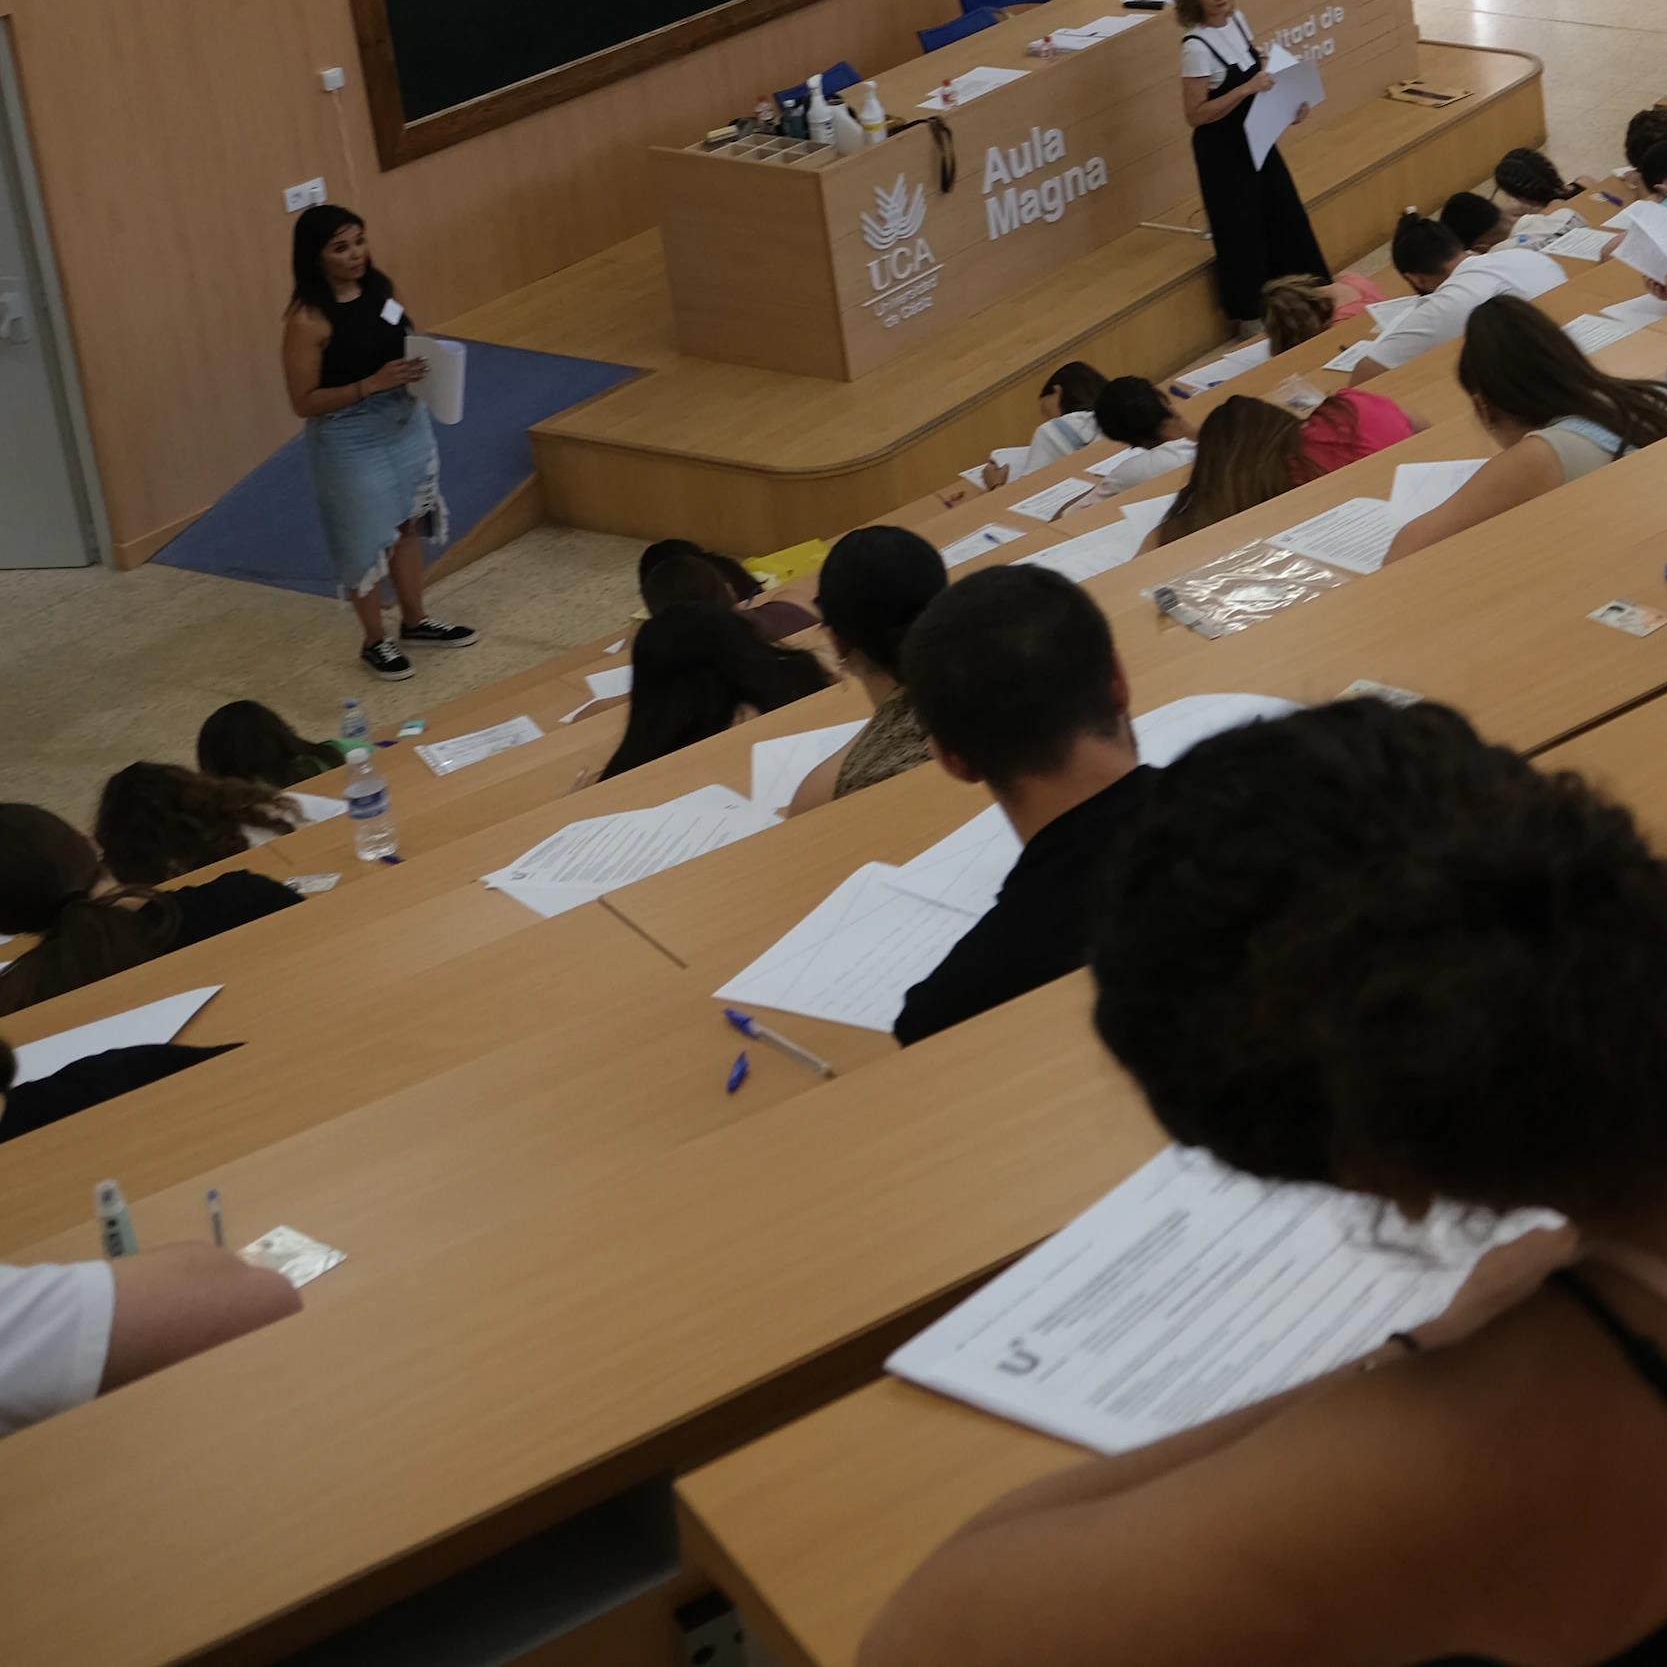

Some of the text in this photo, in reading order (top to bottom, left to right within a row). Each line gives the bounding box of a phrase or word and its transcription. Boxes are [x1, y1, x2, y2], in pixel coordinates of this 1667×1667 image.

[1320, 5, 1345, 29] de
[982, 126, 1068, 195] Aula
[985, 155, 1108, 241] Magna
[866, 238, 937, 292] UCA
